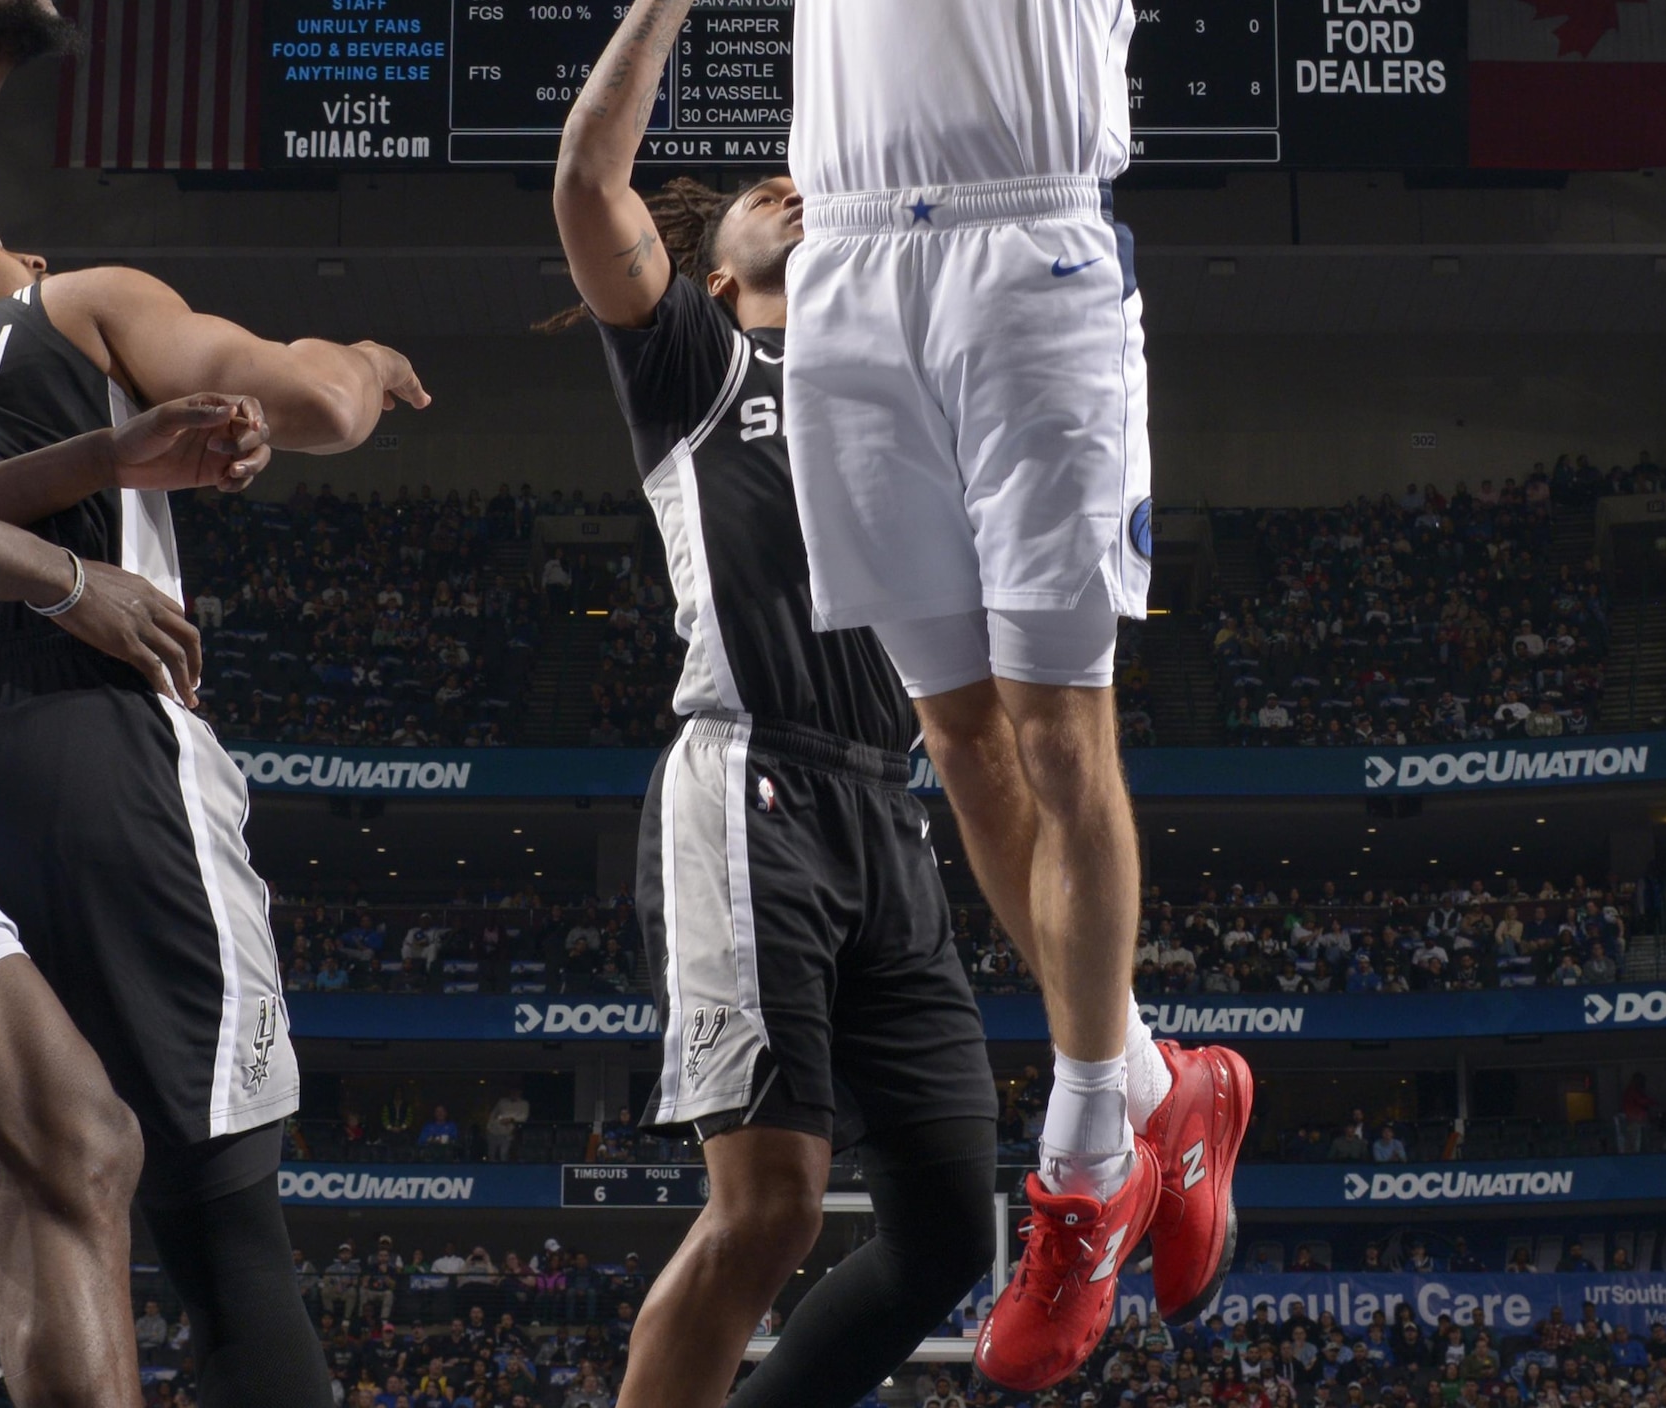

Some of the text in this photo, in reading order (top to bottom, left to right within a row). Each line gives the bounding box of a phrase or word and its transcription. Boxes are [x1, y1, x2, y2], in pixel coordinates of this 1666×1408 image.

[468, 5, 504, 21] FGS
[297, 18, 421, 34] UNRULY FANS
[706, 18, 780, 33] HARPER
[1326, 19, 1415, 54] FORD
[272, 42, 445, 58] FOOD & BEVERAGE
[705, 41, 791, 56] JOHNSON
[285, 65, 430, 81] ANYTHING ELSE
[469, 65, 502, 81] FTS
[706, 63, 774, 78] CASTLE
[1296, 59, 1447, 95] DEALERS
[705, 85, 783, 100] VASSELL
[322, 93, 391, 125] visit
[284, 130, 430, 158] TellAAC.com
[648, 139, 787, 158] YOUR MAVS
[1398, 742, 1649, 789] DOCUMATION
[1141, 1004, 1303, 1034] CUMATION
[573, 1168, 681, 1180] TIMEOUTS FOULS
[1371, 1169, 1572, 1201] DOCUMATION
[593, 1185, 668, 1203] 6 2
[1417, 1282, 1532, 1327] Care
